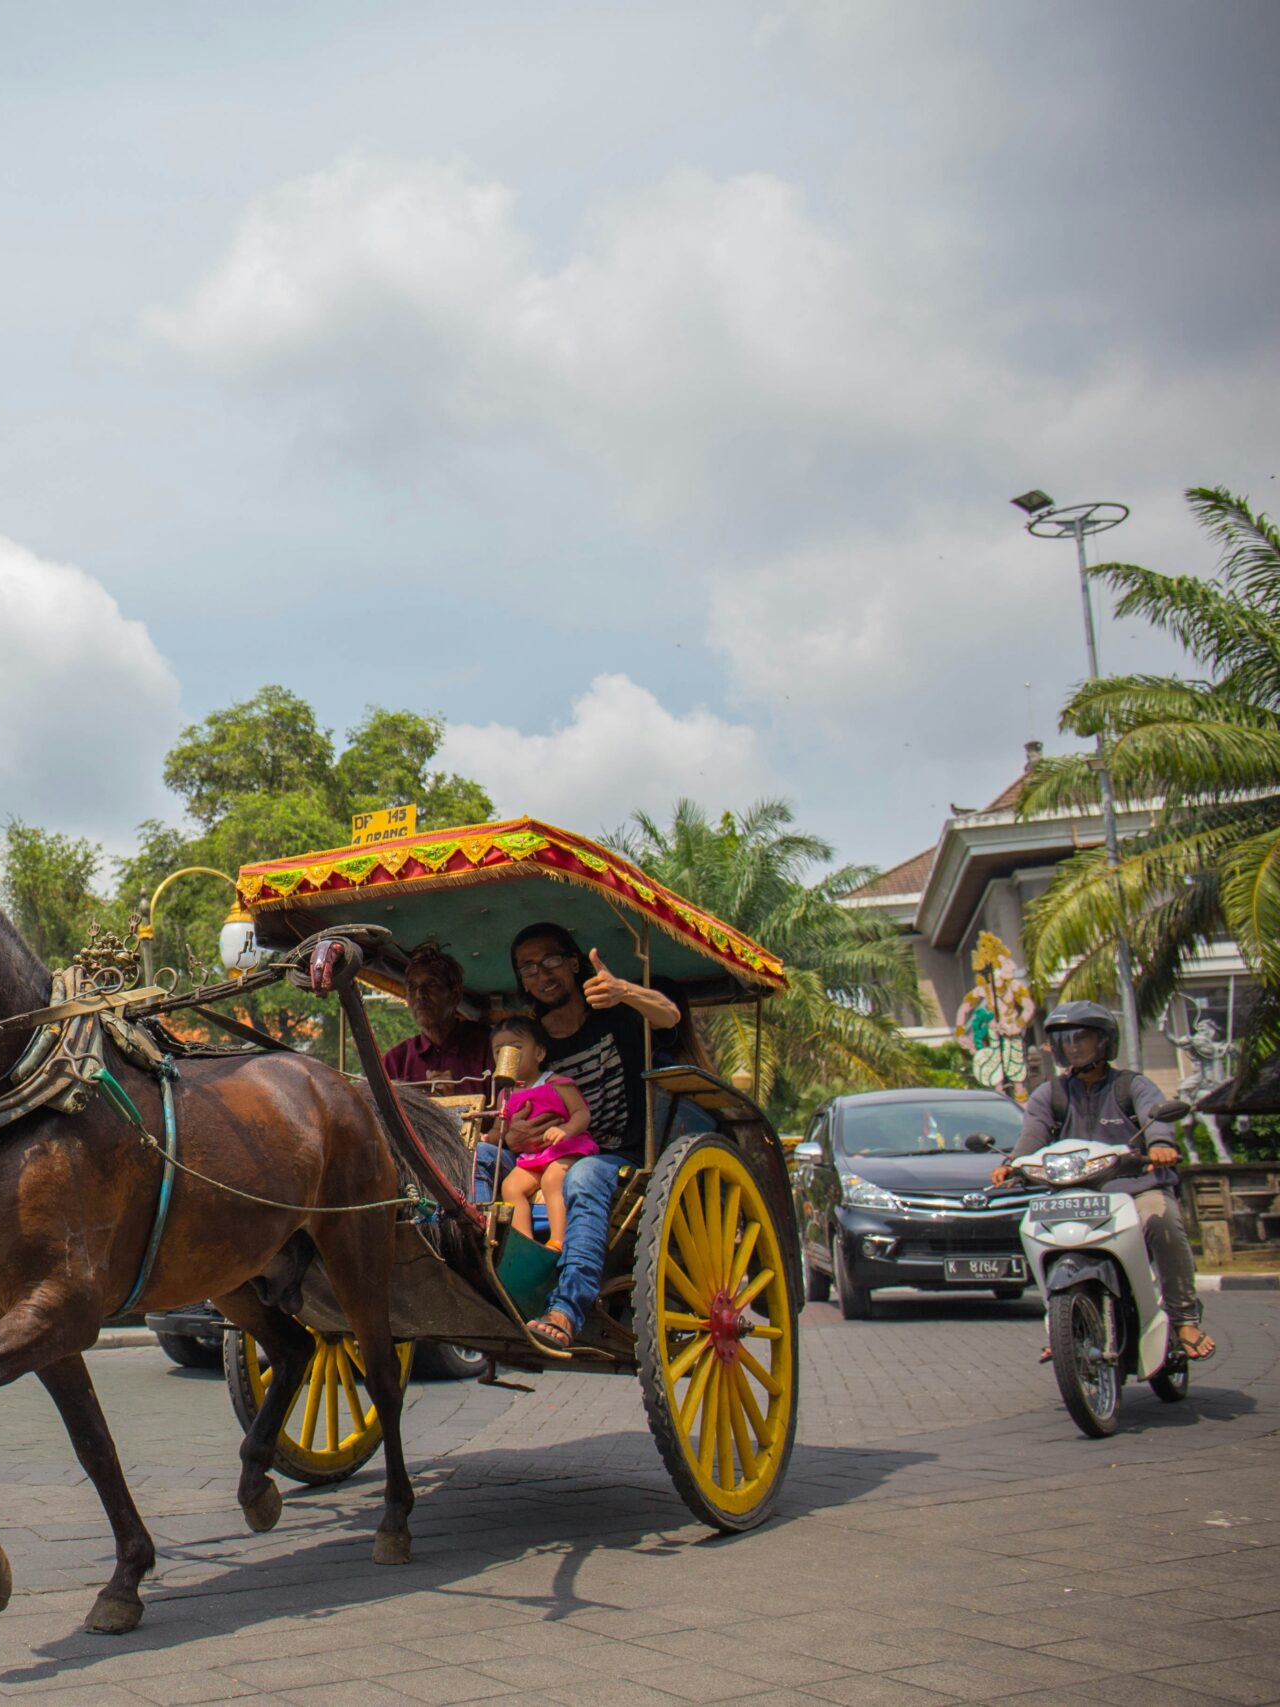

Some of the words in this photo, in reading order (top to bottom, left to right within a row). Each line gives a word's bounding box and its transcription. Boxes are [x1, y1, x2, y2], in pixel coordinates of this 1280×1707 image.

[387, 808, 407, 824] 145
[1032, 1199, 1048, 1211] DK
[1050, 1198, 1080, 1210] 2963
[948, 1260, 957, 1273] K
[1011, 1259, 1021, 1273] L
